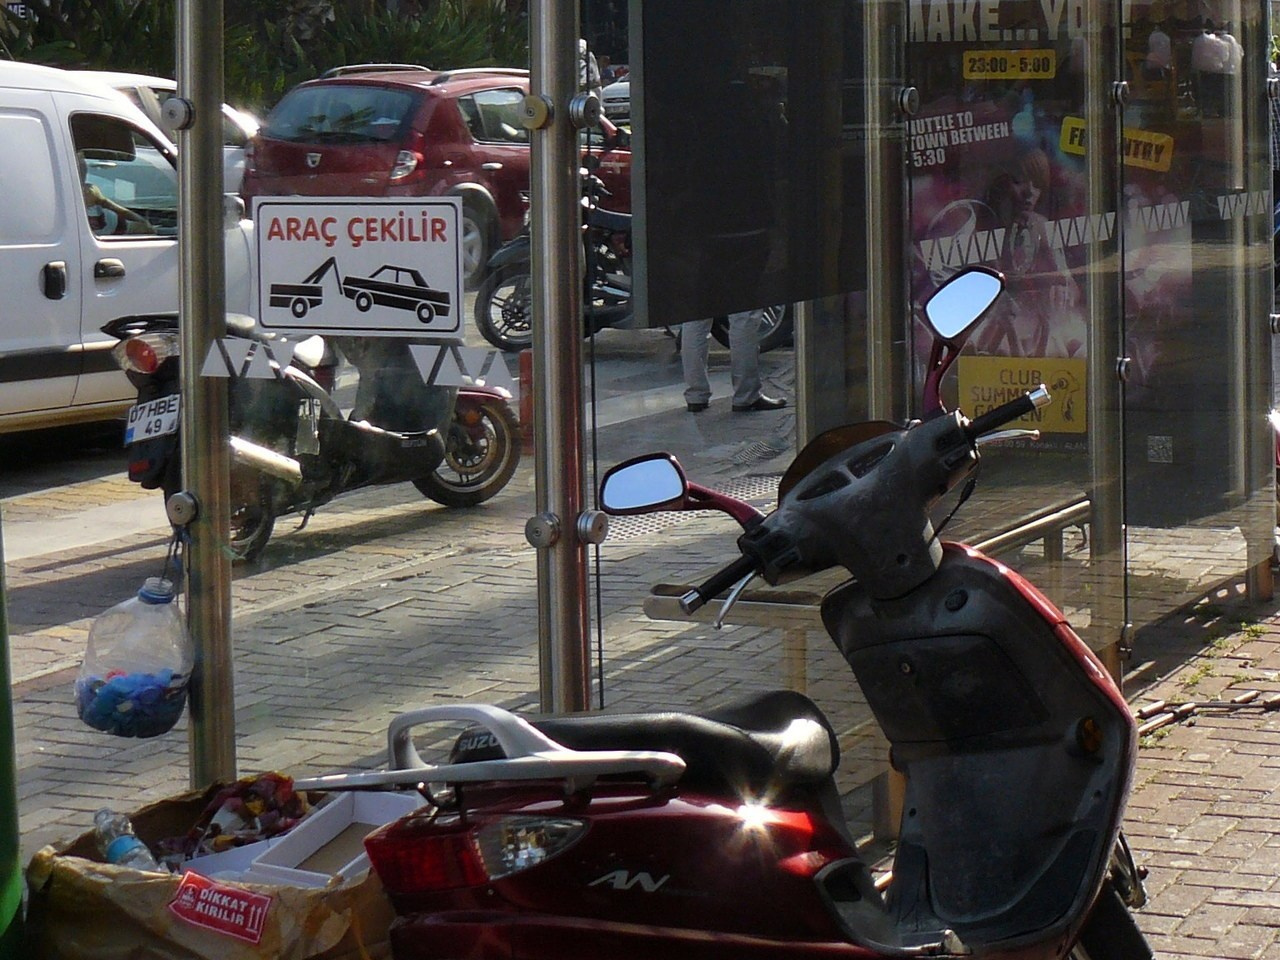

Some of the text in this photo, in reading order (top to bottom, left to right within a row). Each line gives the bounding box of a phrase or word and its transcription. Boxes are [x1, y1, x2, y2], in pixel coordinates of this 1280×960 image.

[969, 57, 1008, 73] 23:00
[1020, 57, 1050, 73] 5:00
[956, 111, 974, 128] TO
[951, 121, 1010, 146] BETWEEN
[912, 148, 946, 168] 5:30
[267, 210, 449, 248] ARAÇ ÇEKİLİR
[999, 369, 1042, 385] CLUB
[147, 397, 178, 418] HBE
[145, 418, 162, 436] 49
[200, 888, 249, 913] DİKKAT
